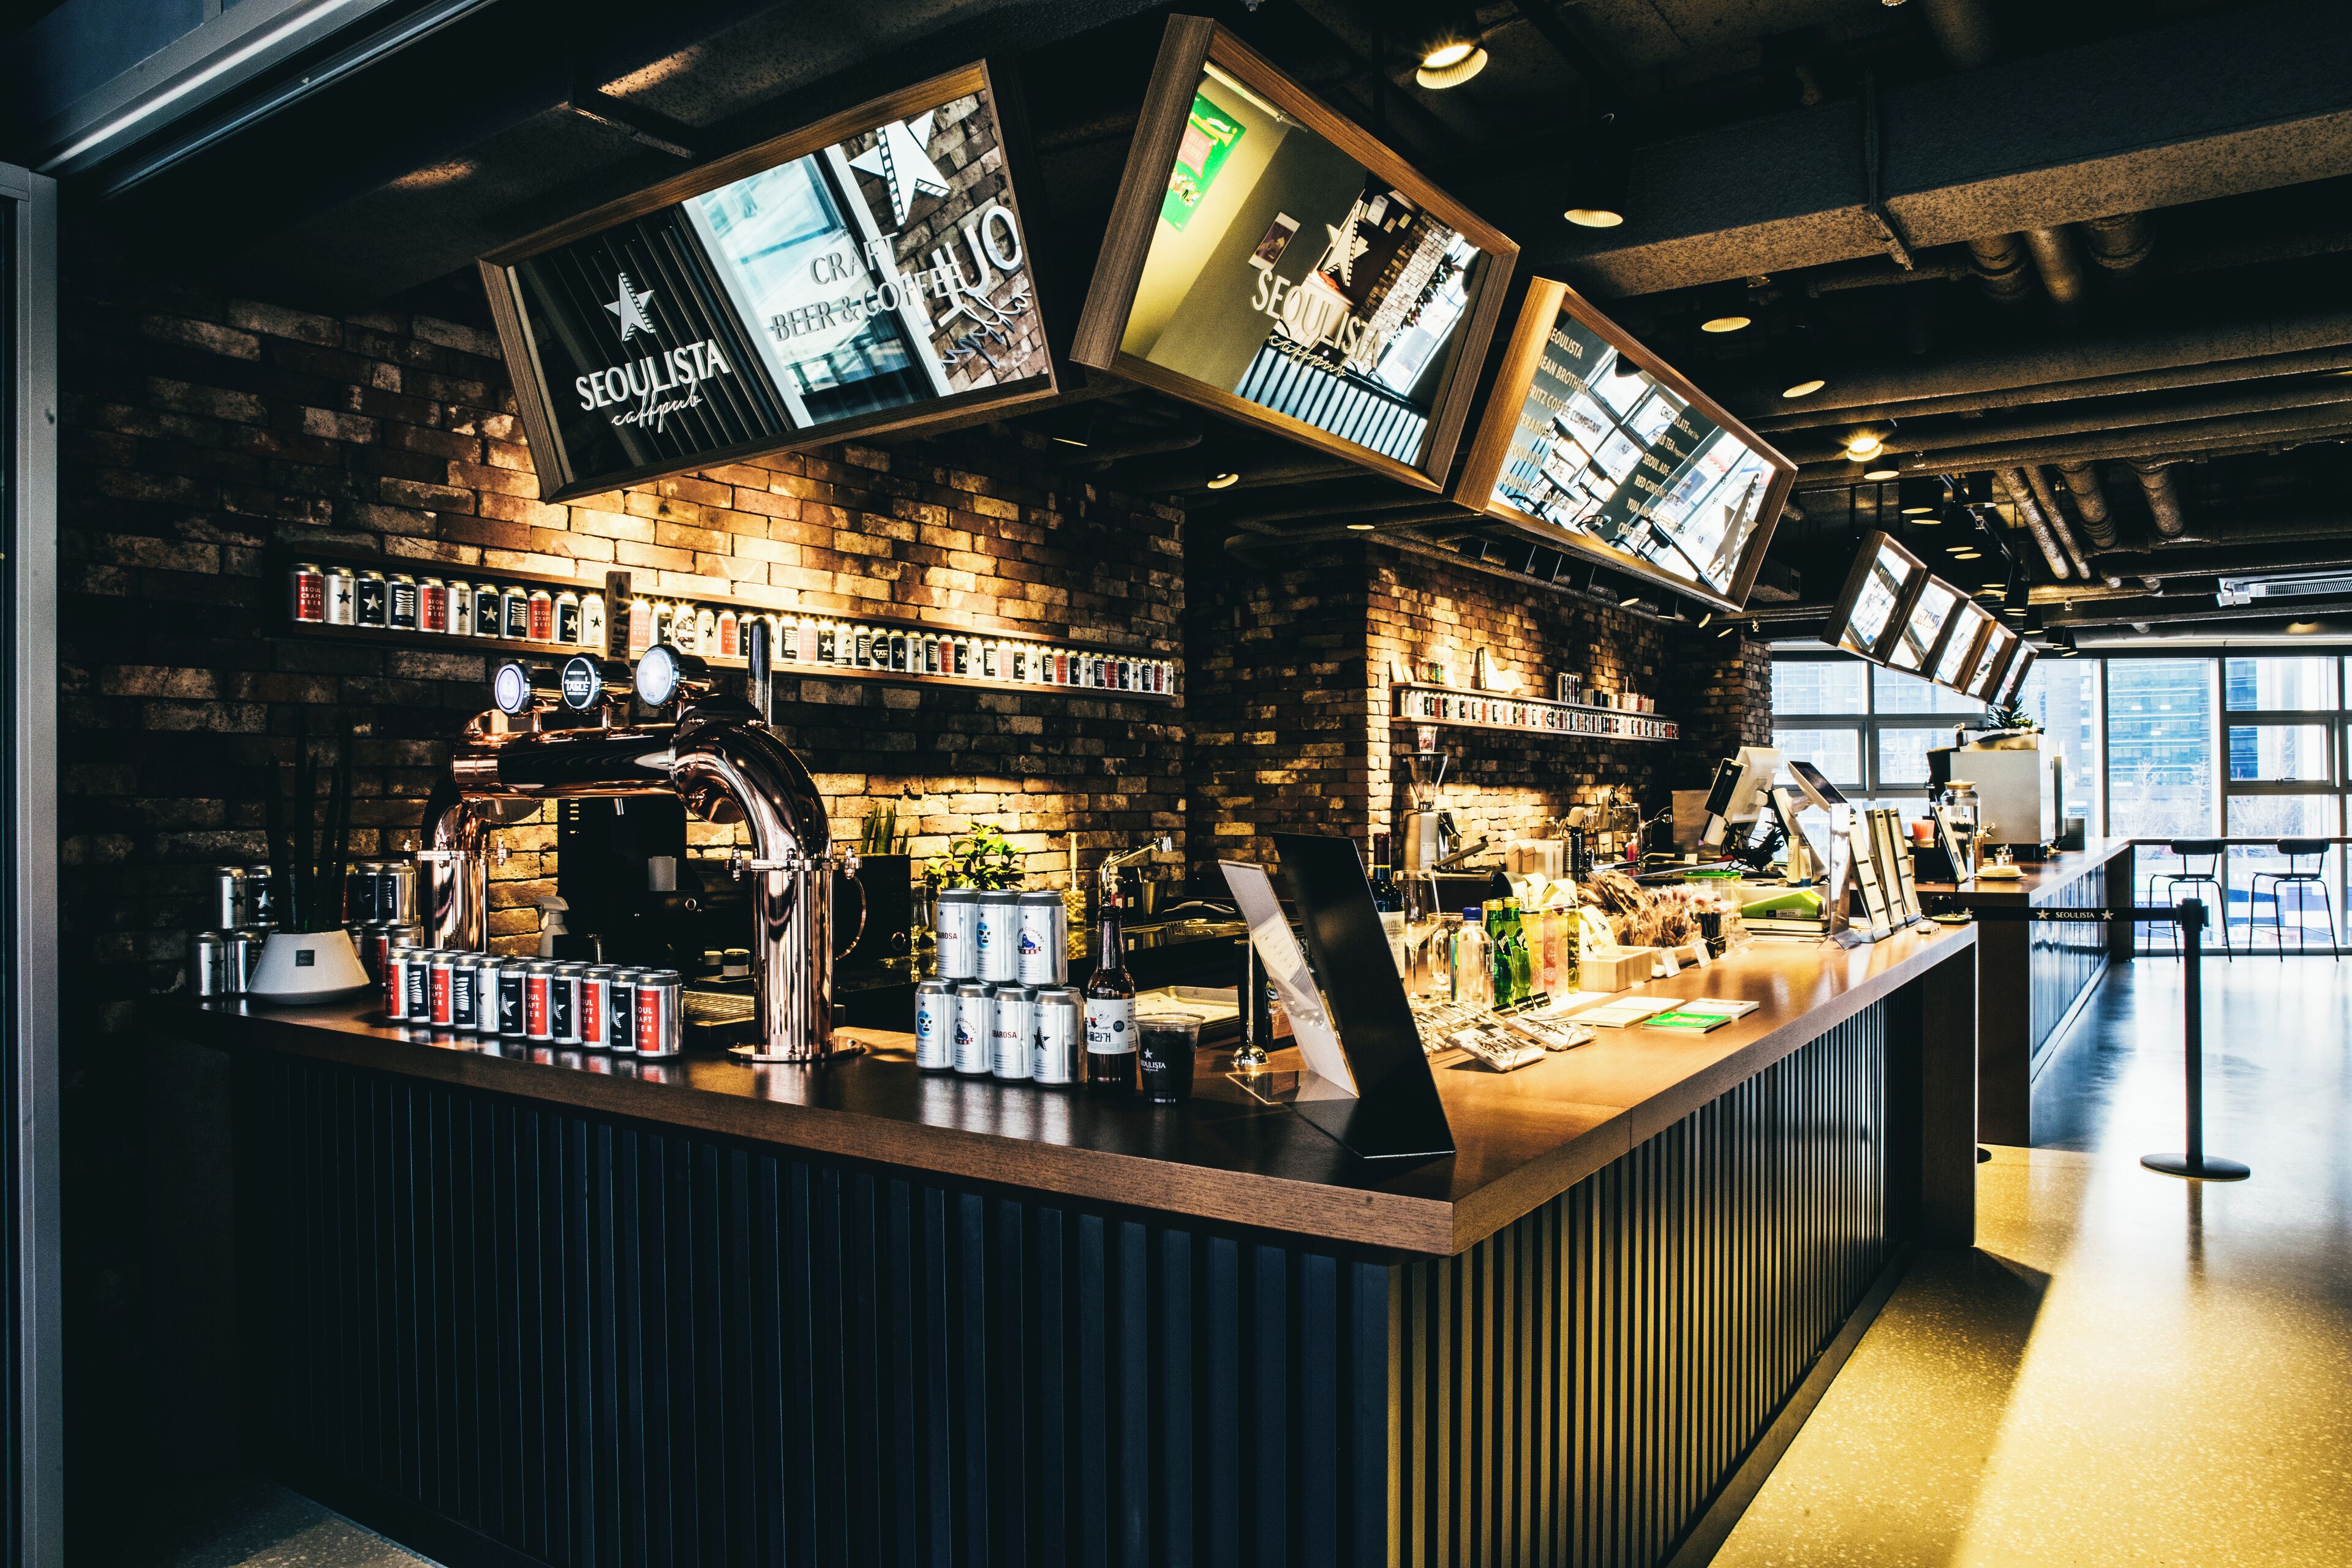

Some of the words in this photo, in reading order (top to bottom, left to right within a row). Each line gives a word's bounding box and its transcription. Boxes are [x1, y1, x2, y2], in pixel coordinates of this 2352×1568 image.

[809, 232, 900, 285] CRAFT
[771, 301, 836, 342] BEER
[839, 295, 860, 323] &
[860, 261, 968, 317] COFFEE
[1251, 268, 1381, 369] SEOULISTA
[1550, 327, 1583, 360] EOULISTA
[575, 339, 732, 411] SEOULISTA
[1556, 365, 1589, 396] BROTHERS
[1570, 409, 1602, 435] COMPANY
[1660, 405, 1691, 434] CHOCOLATE
[1665, 436, 1676, 452] TEA
[1642, 452, 1659, 470] SEOUL
[1659, 461, 1671, 478] ADE
[1634, 473, 1646, 489] RED
[1645, 479, 1669, 501] GINSENG
[1626, 497, 1640, 514] YUJA
[1637, 505, 1652, 519] AND
[1025, 926, 1044, 943] COMPANY
[431, 982, 443, 990] OUL
[636, 1024, 652, 1033] EER
[1088, 1031, 1111, 1042] 울라거
[1140, 1059, 1166, 1069] EOULISTA
